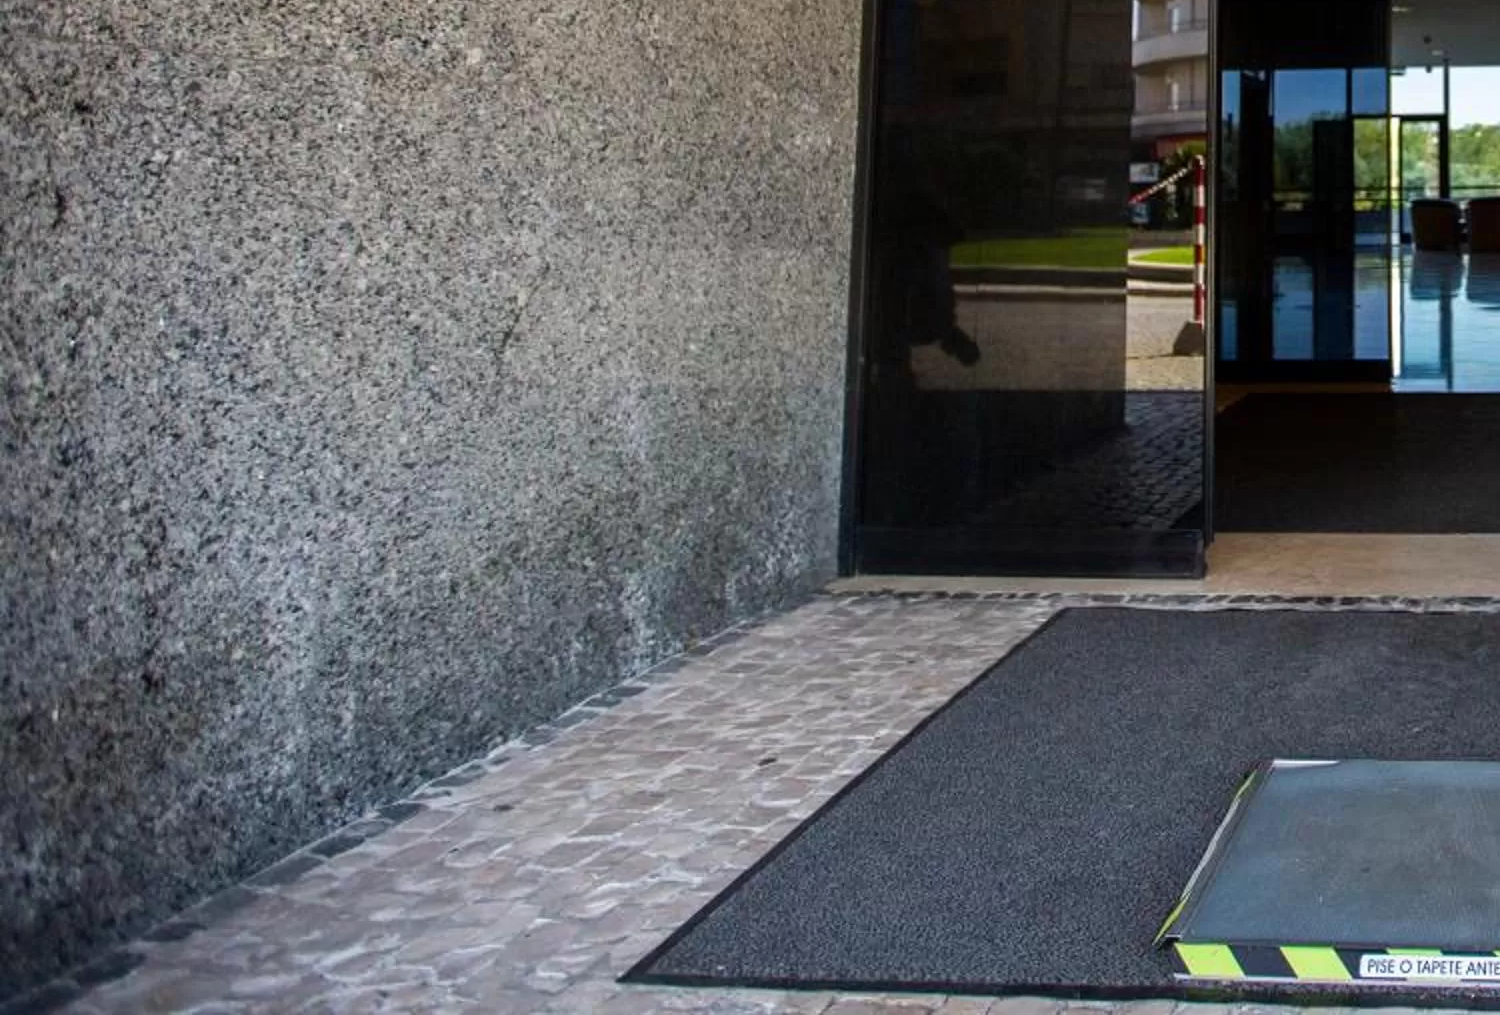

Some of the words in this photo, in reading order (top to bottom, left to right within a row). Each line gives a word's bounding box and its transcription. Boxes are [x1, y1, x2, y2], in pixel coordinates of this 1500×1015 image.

[1366, 958, 1395, 974] PISE
[1399, 959, 1412, 974] O
[1416, 960, 1463, 976] TAPETE
